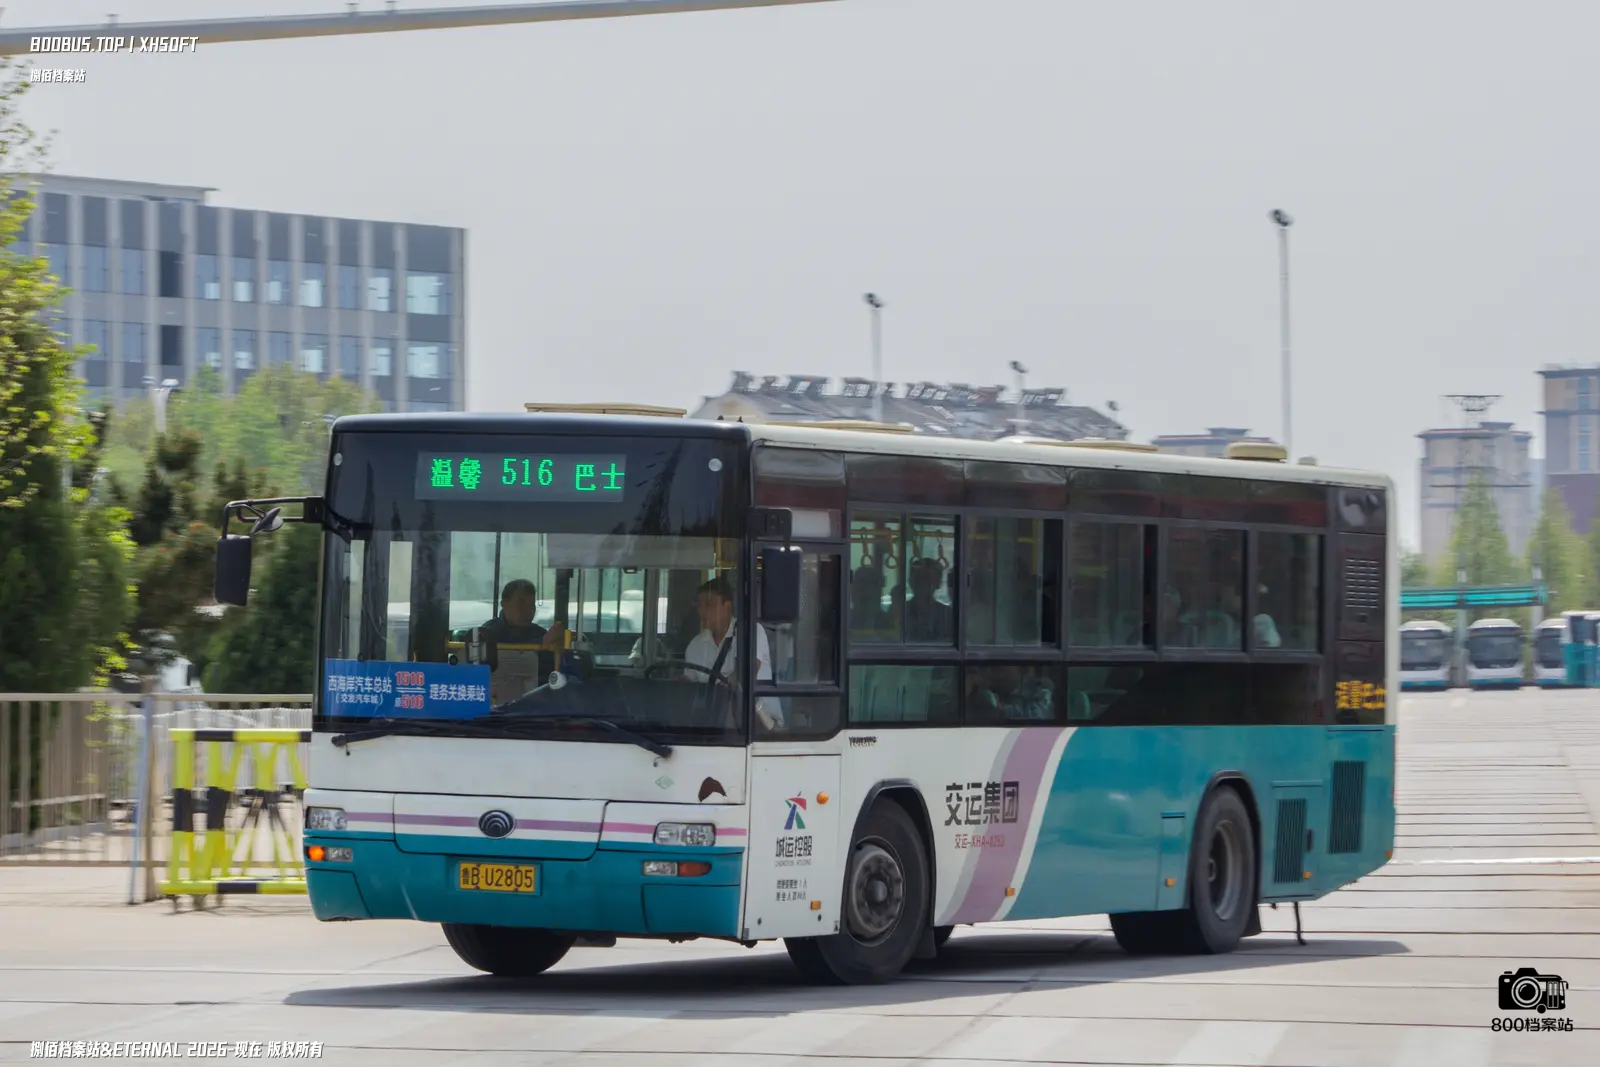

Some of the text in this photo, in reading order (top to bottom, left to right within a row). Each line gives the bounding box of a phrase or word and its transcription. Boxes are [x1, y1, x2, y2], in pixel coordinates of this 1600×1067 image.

[431, 457, 626, 492] 温馨 516 巴士
[328, 675, 393, 694] 西海岸汽车总站
[394, 671, 426, 687] 1516
[429, 683, 487, 703] 理务关换乘站
[944, 781, 1019, 826] 交运集团
[775, 836, 812, 858] 城运控股
